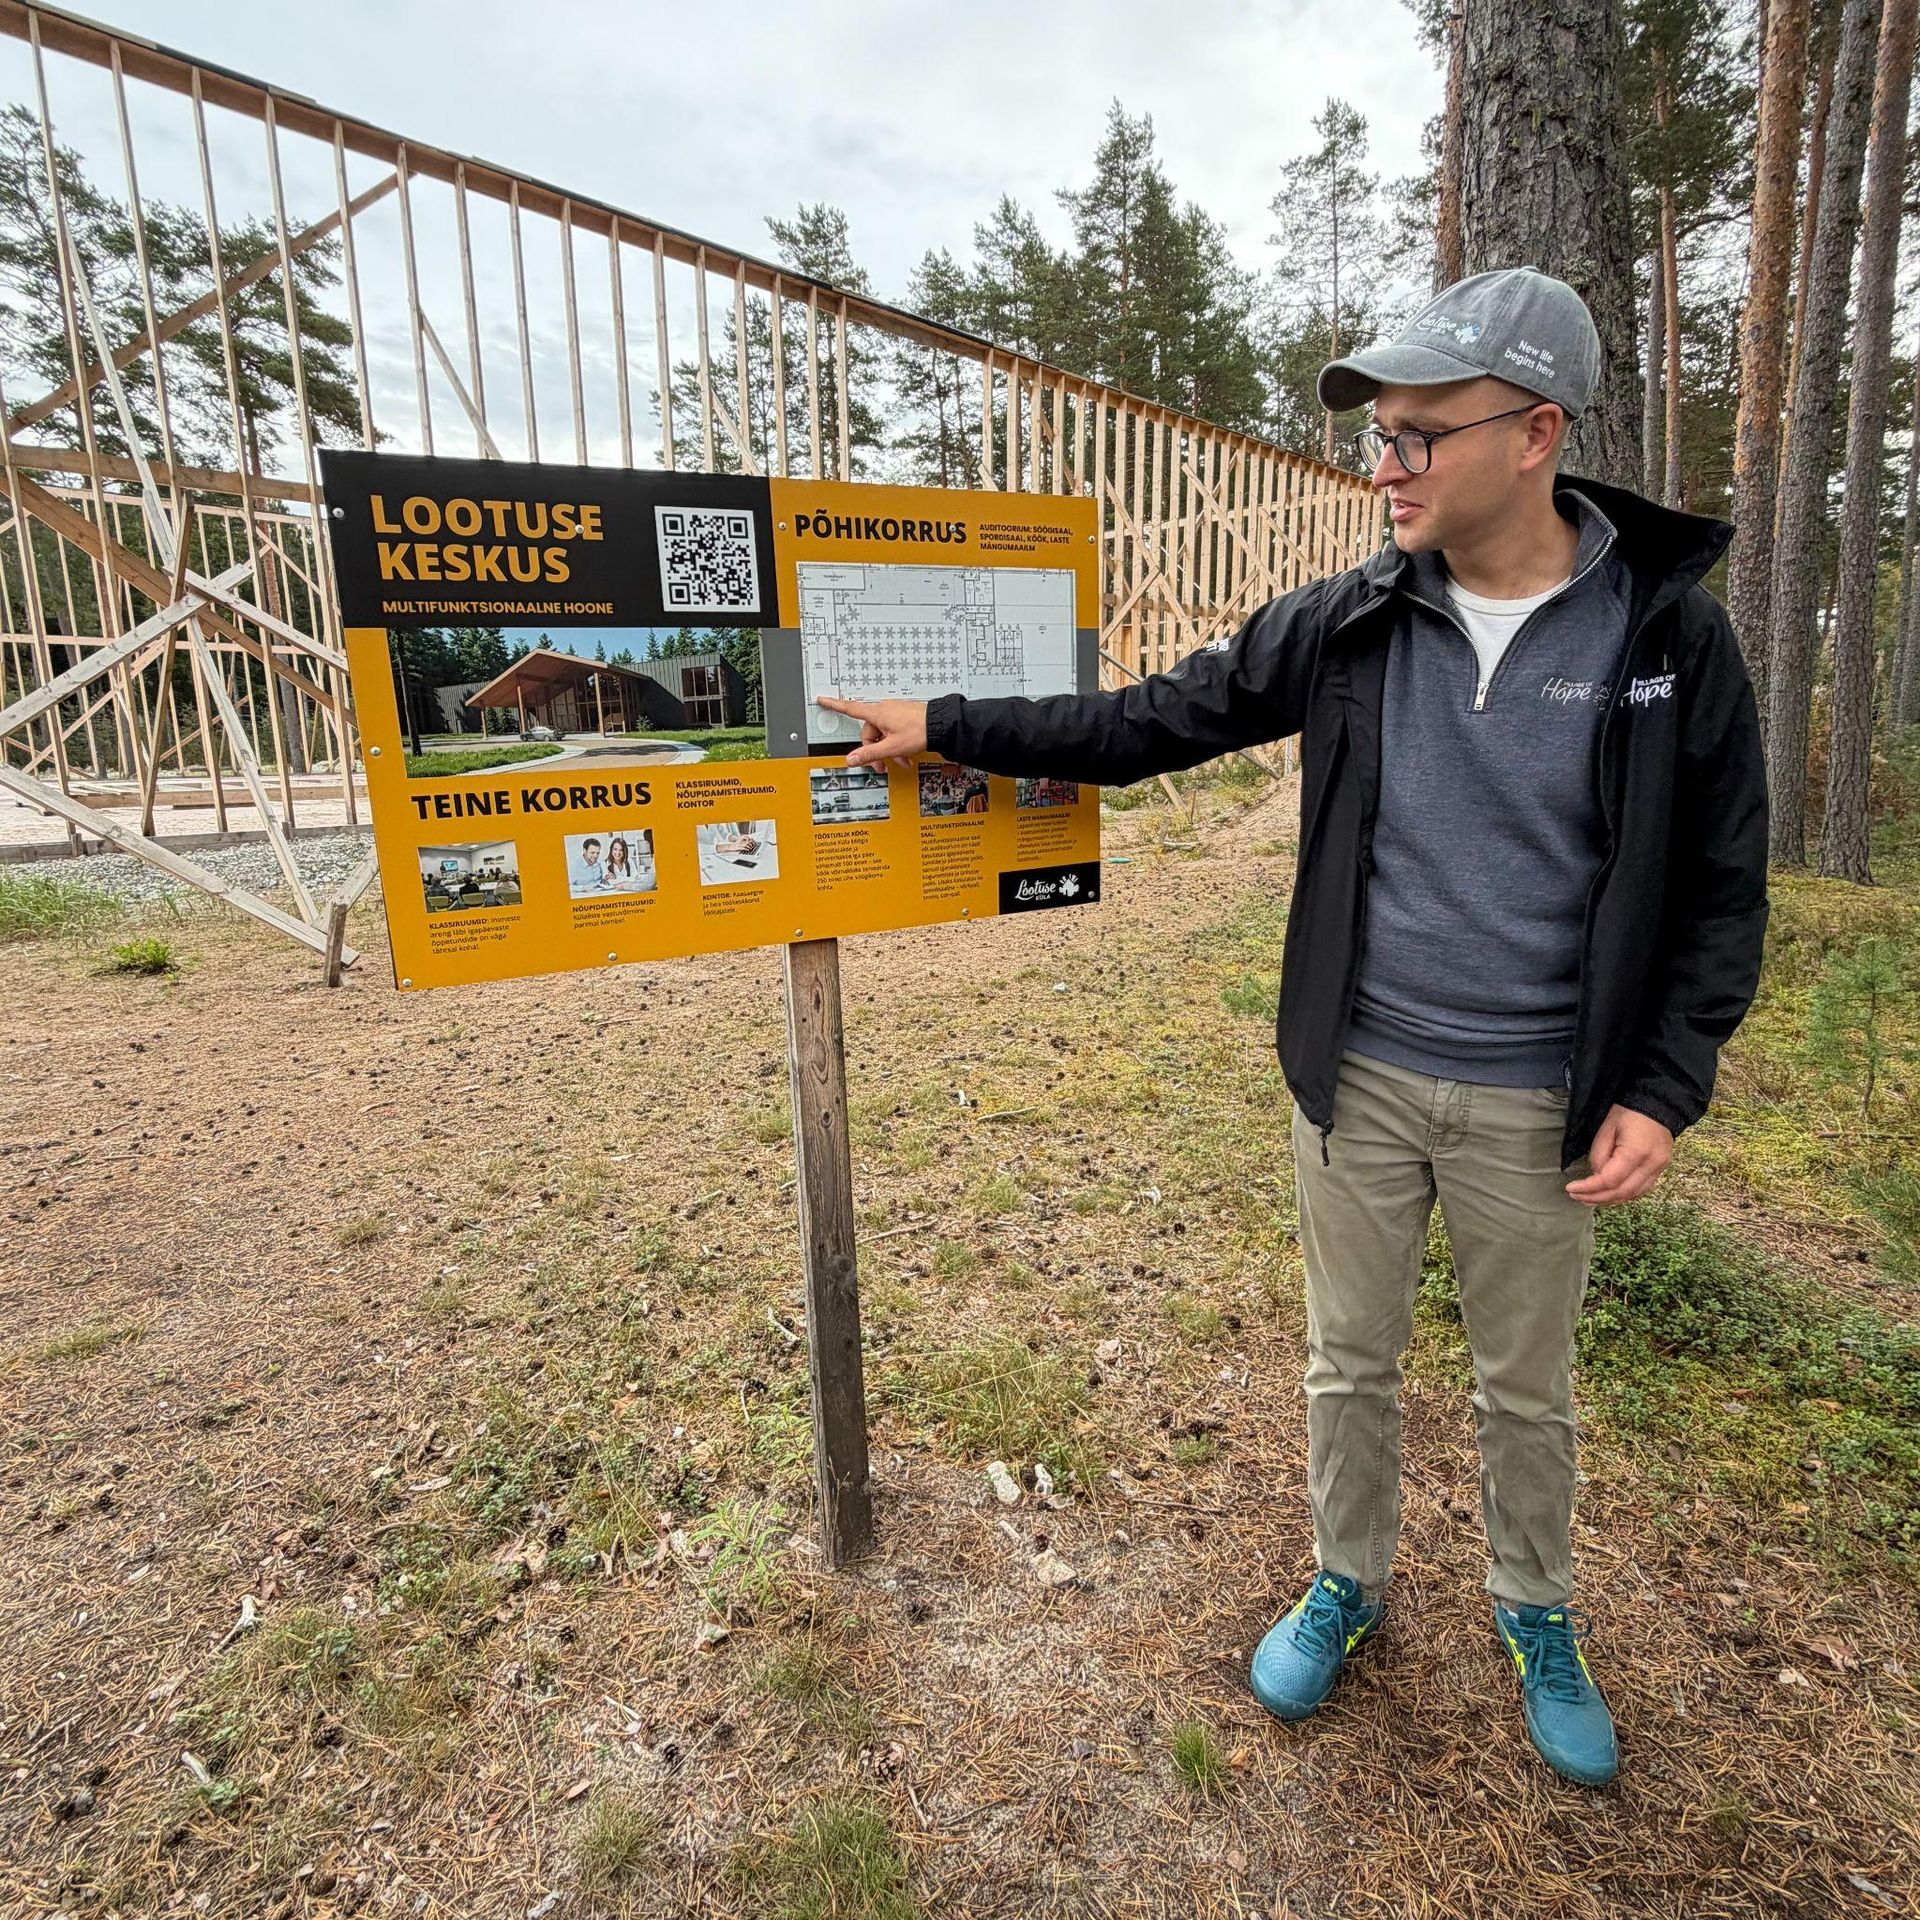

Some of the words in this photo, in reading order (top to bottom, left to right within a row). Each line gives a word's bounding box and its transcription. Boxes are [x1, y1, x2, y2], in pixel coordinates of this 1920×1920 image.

[1518, 340, 1539, 358] New
[1539, 349, 1555, 364] life
[1504, 347, 1536, 370] begins
[1536, 362, 1556, 379] here
[370, 494, 604, 541] LOOTUSE
[795, 509, 967, 544] PÕHIKORRUS
[980, 524, 1032, 533] AUDITOORIUM:
[980, 534, 1026, 543] SPORDISAAL,
[377, 542, 570, 583] KESKUS
[382, 601, 562, 614] MULTIFUNKTSIONAALNE
[564, 602, 614, 614] HOONE
[1637, 675, 1664, 687] VILLAGE
[1665, 673, 1677, 681] OF
[1541, 676, 1592, 705] Hope
[676, 779, 742, 790] KLASSIRUUMID,
[676, 786, 777, 799] NÕUPIDAMISTERUUMID,
[411, 793, 511, 820] TEINE
[522, 782, 652, 814] KORRUS
[677, 800, 714, 809] KONTOR
[703, 892, 732, 901] KONTOR:
[1015, 879, 1056, 900] Lootuse
[572, 898, 656, 913] NÕUPIDAMISTERUUMID:
[429, 917, 490, 930] KLASSIRUUMID:
